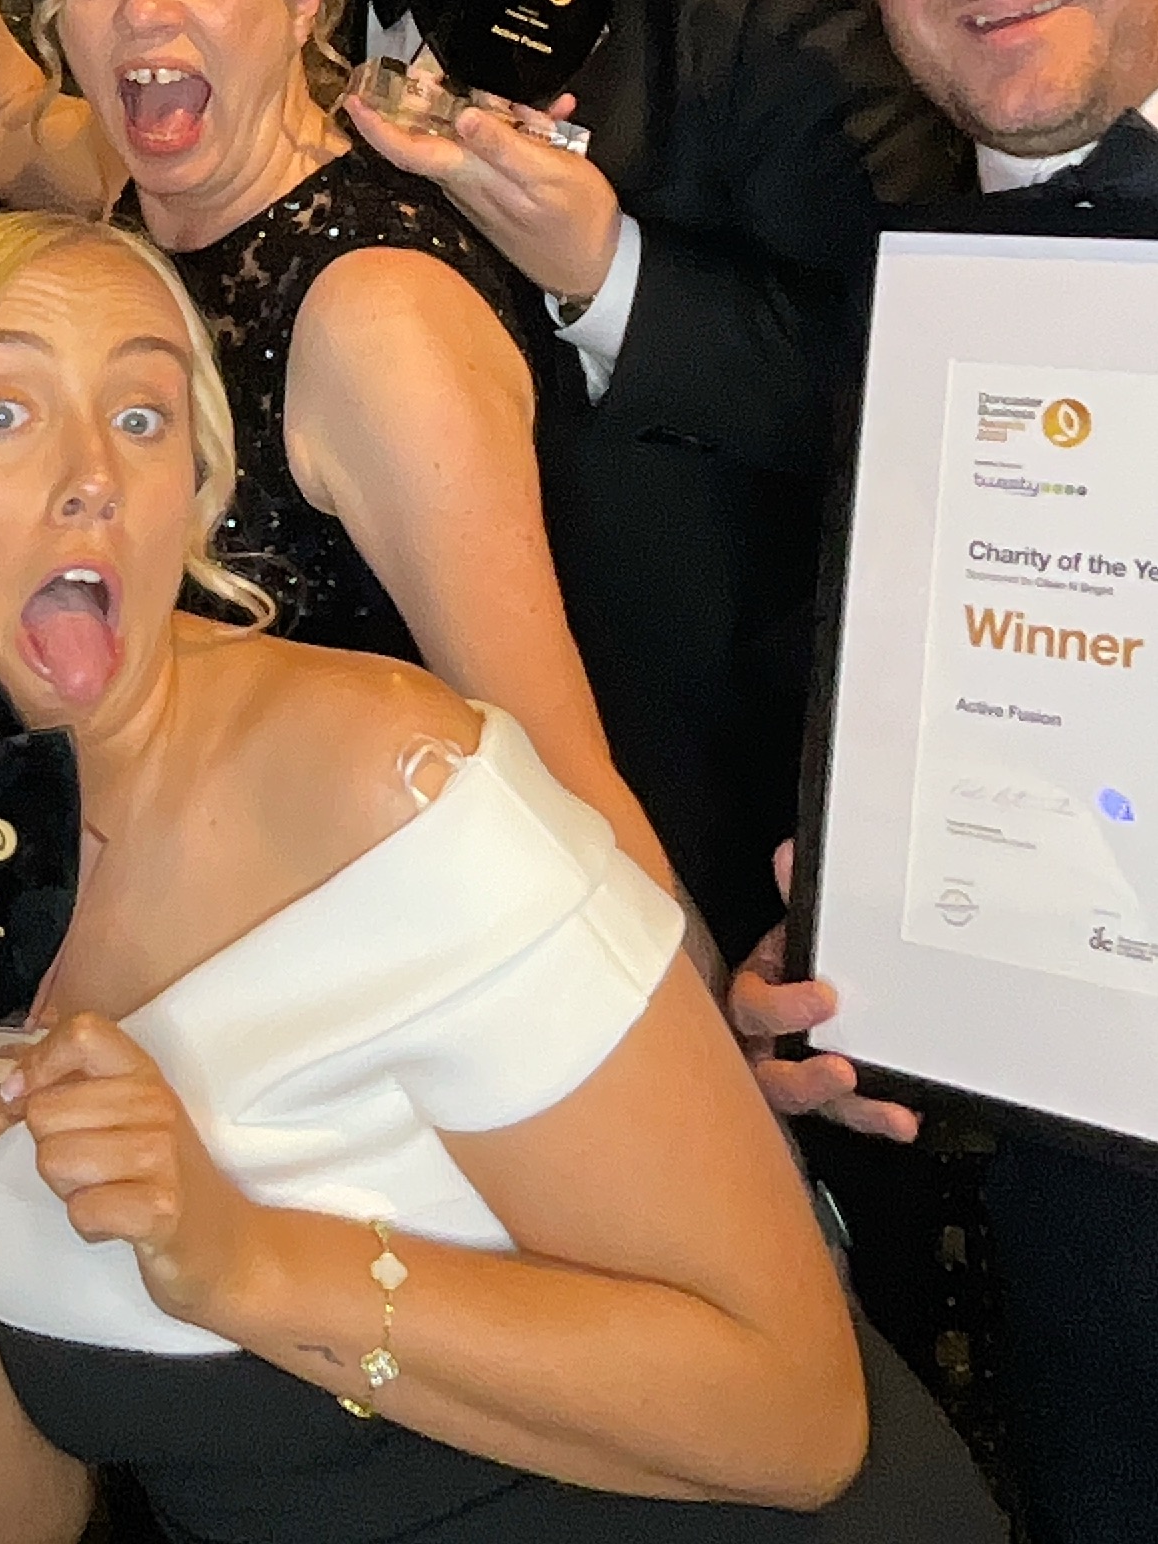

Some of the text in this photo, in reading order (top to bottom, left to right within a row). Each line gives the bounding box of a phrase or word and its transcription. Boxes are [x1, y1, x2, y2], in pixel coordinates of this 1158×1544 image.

[969, 540, 1051, 572] Charity
[1057, 552, 1082, 572] of
[1089, 554, 1127, 578] the
[963, 604, 1144, 668] Winner
[956, 697, 1062, 726] Active Fusion
